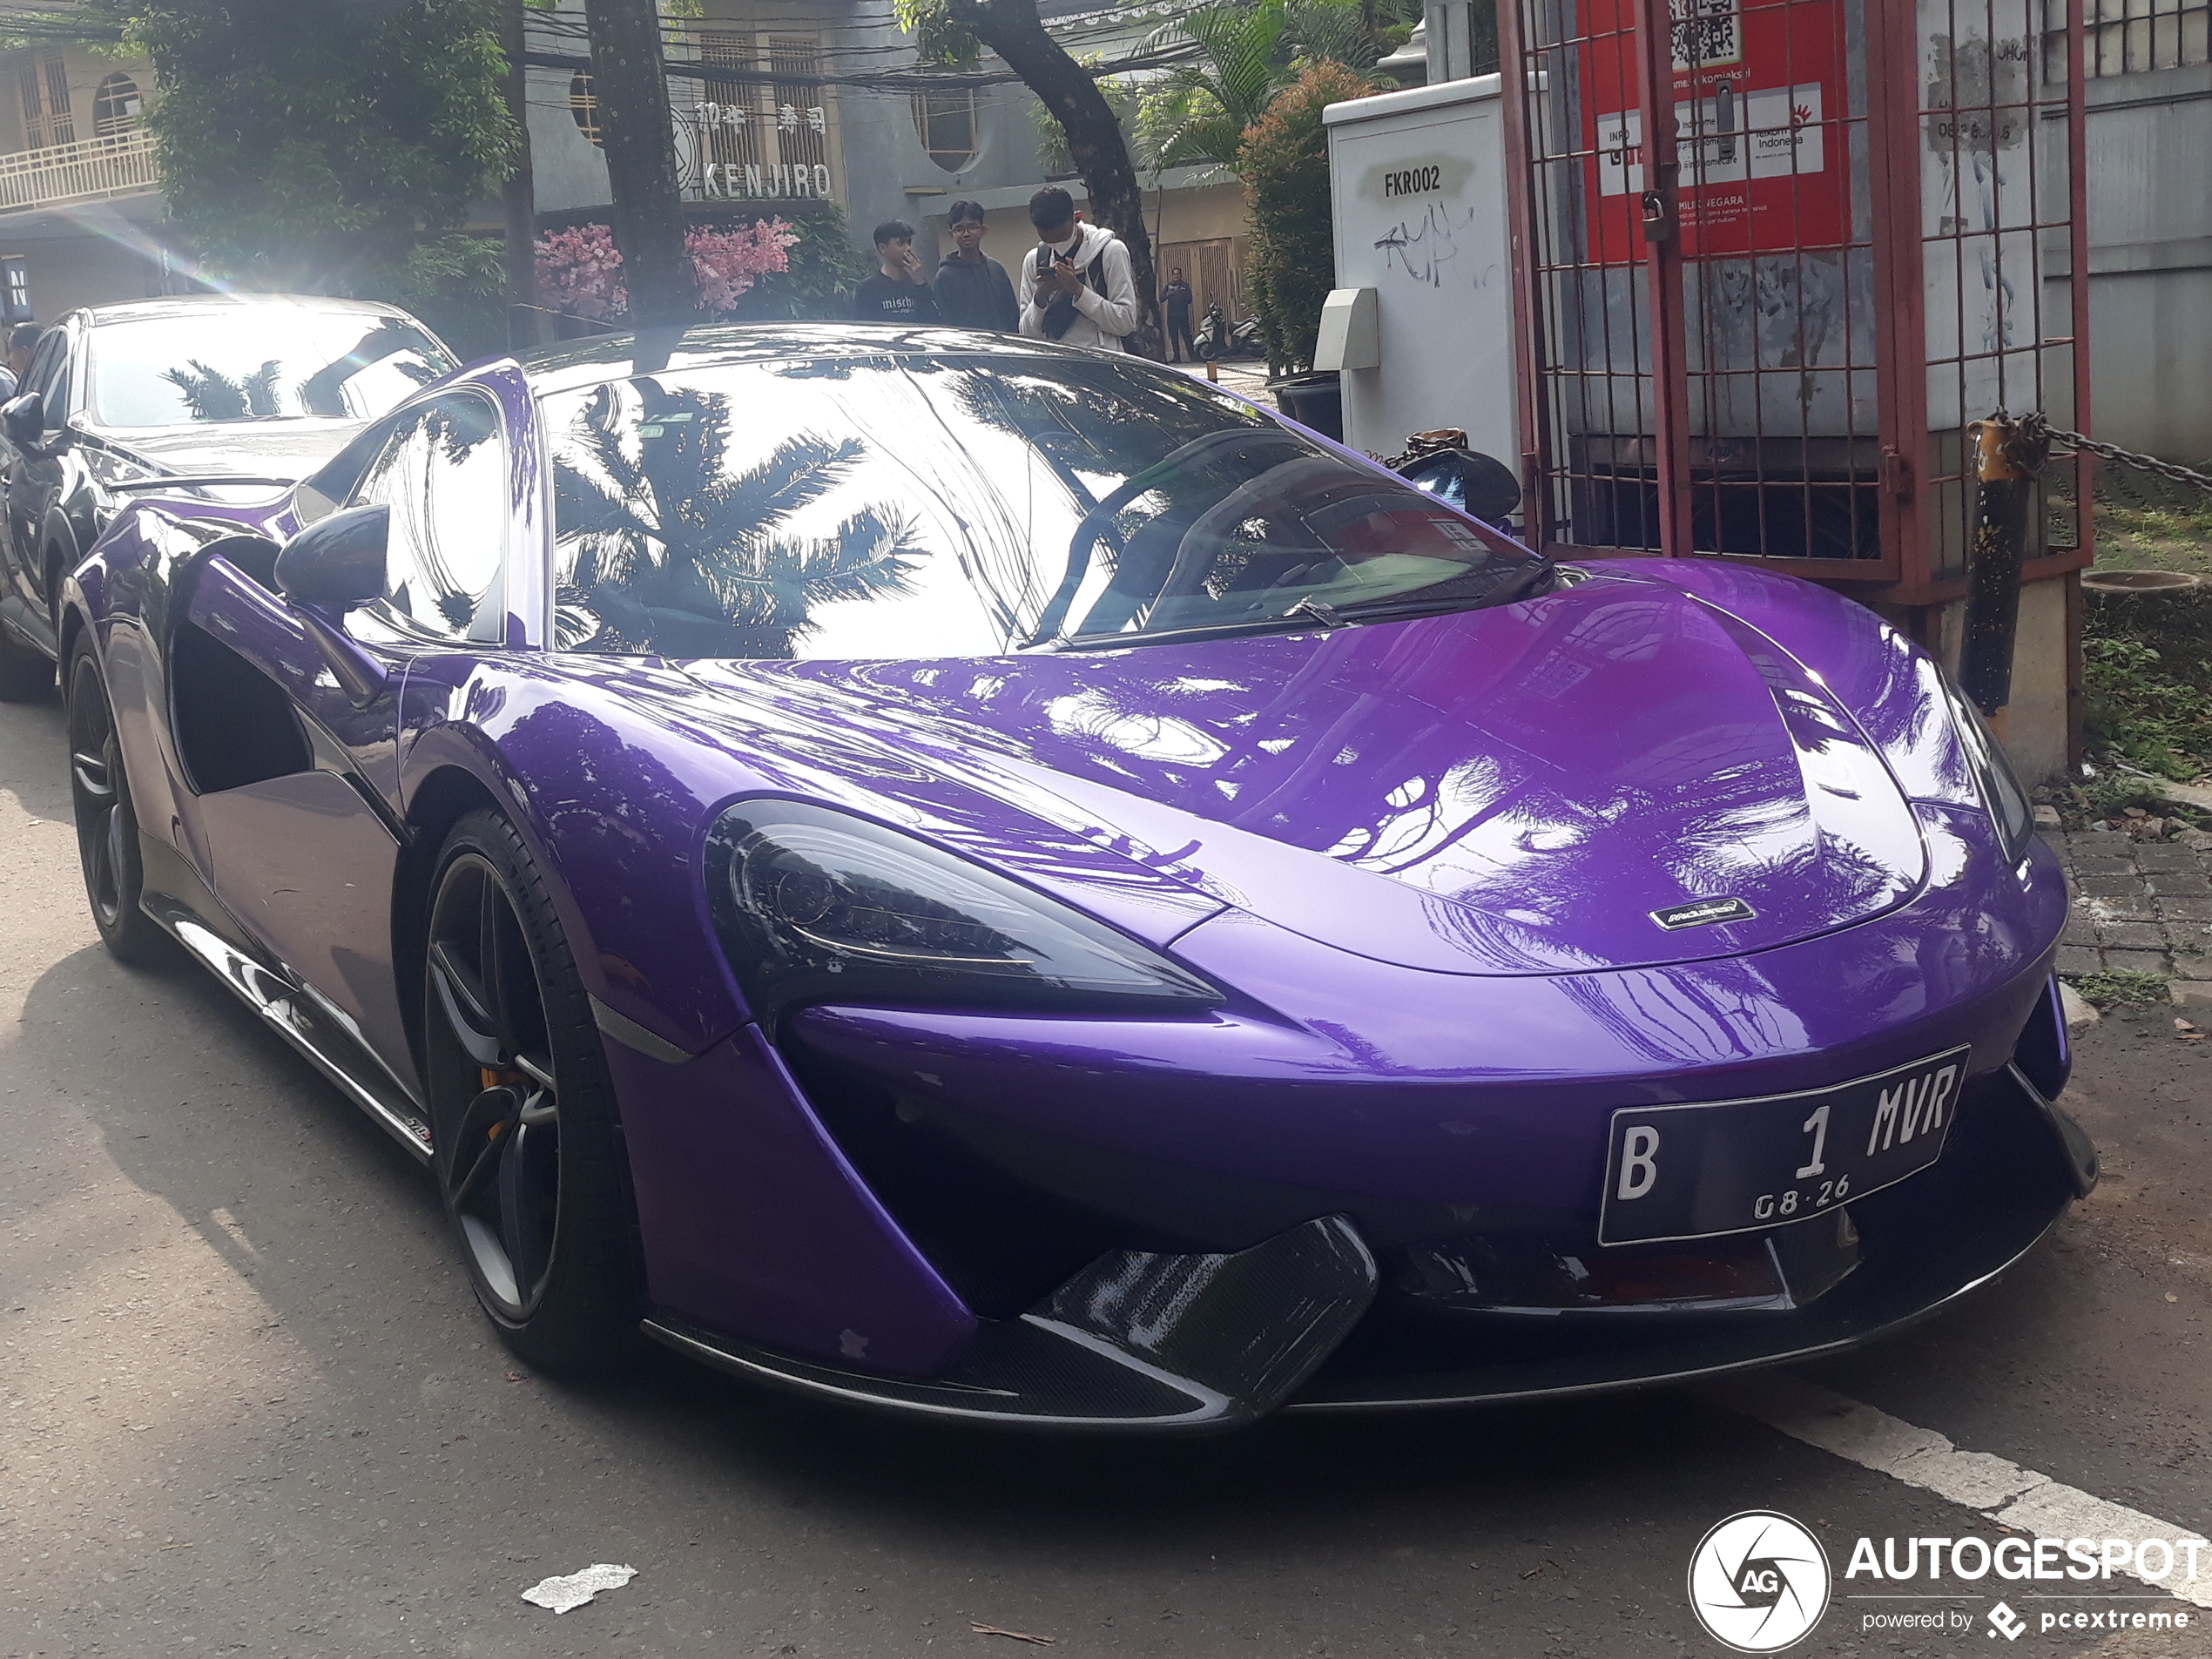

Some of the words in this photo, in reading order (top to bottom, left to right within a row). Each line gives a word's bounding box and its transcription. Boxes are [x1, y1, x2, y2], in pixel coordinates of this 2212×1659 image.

[703, 163, 830, 199] KENJIRO
[1385, 165, 1440, 198] FKR002
[1617, 1125, 1660, 1201] B
[1795, 1105, 1830, 1180] 1
[1867, 1064, 1958, 1157] MVR
